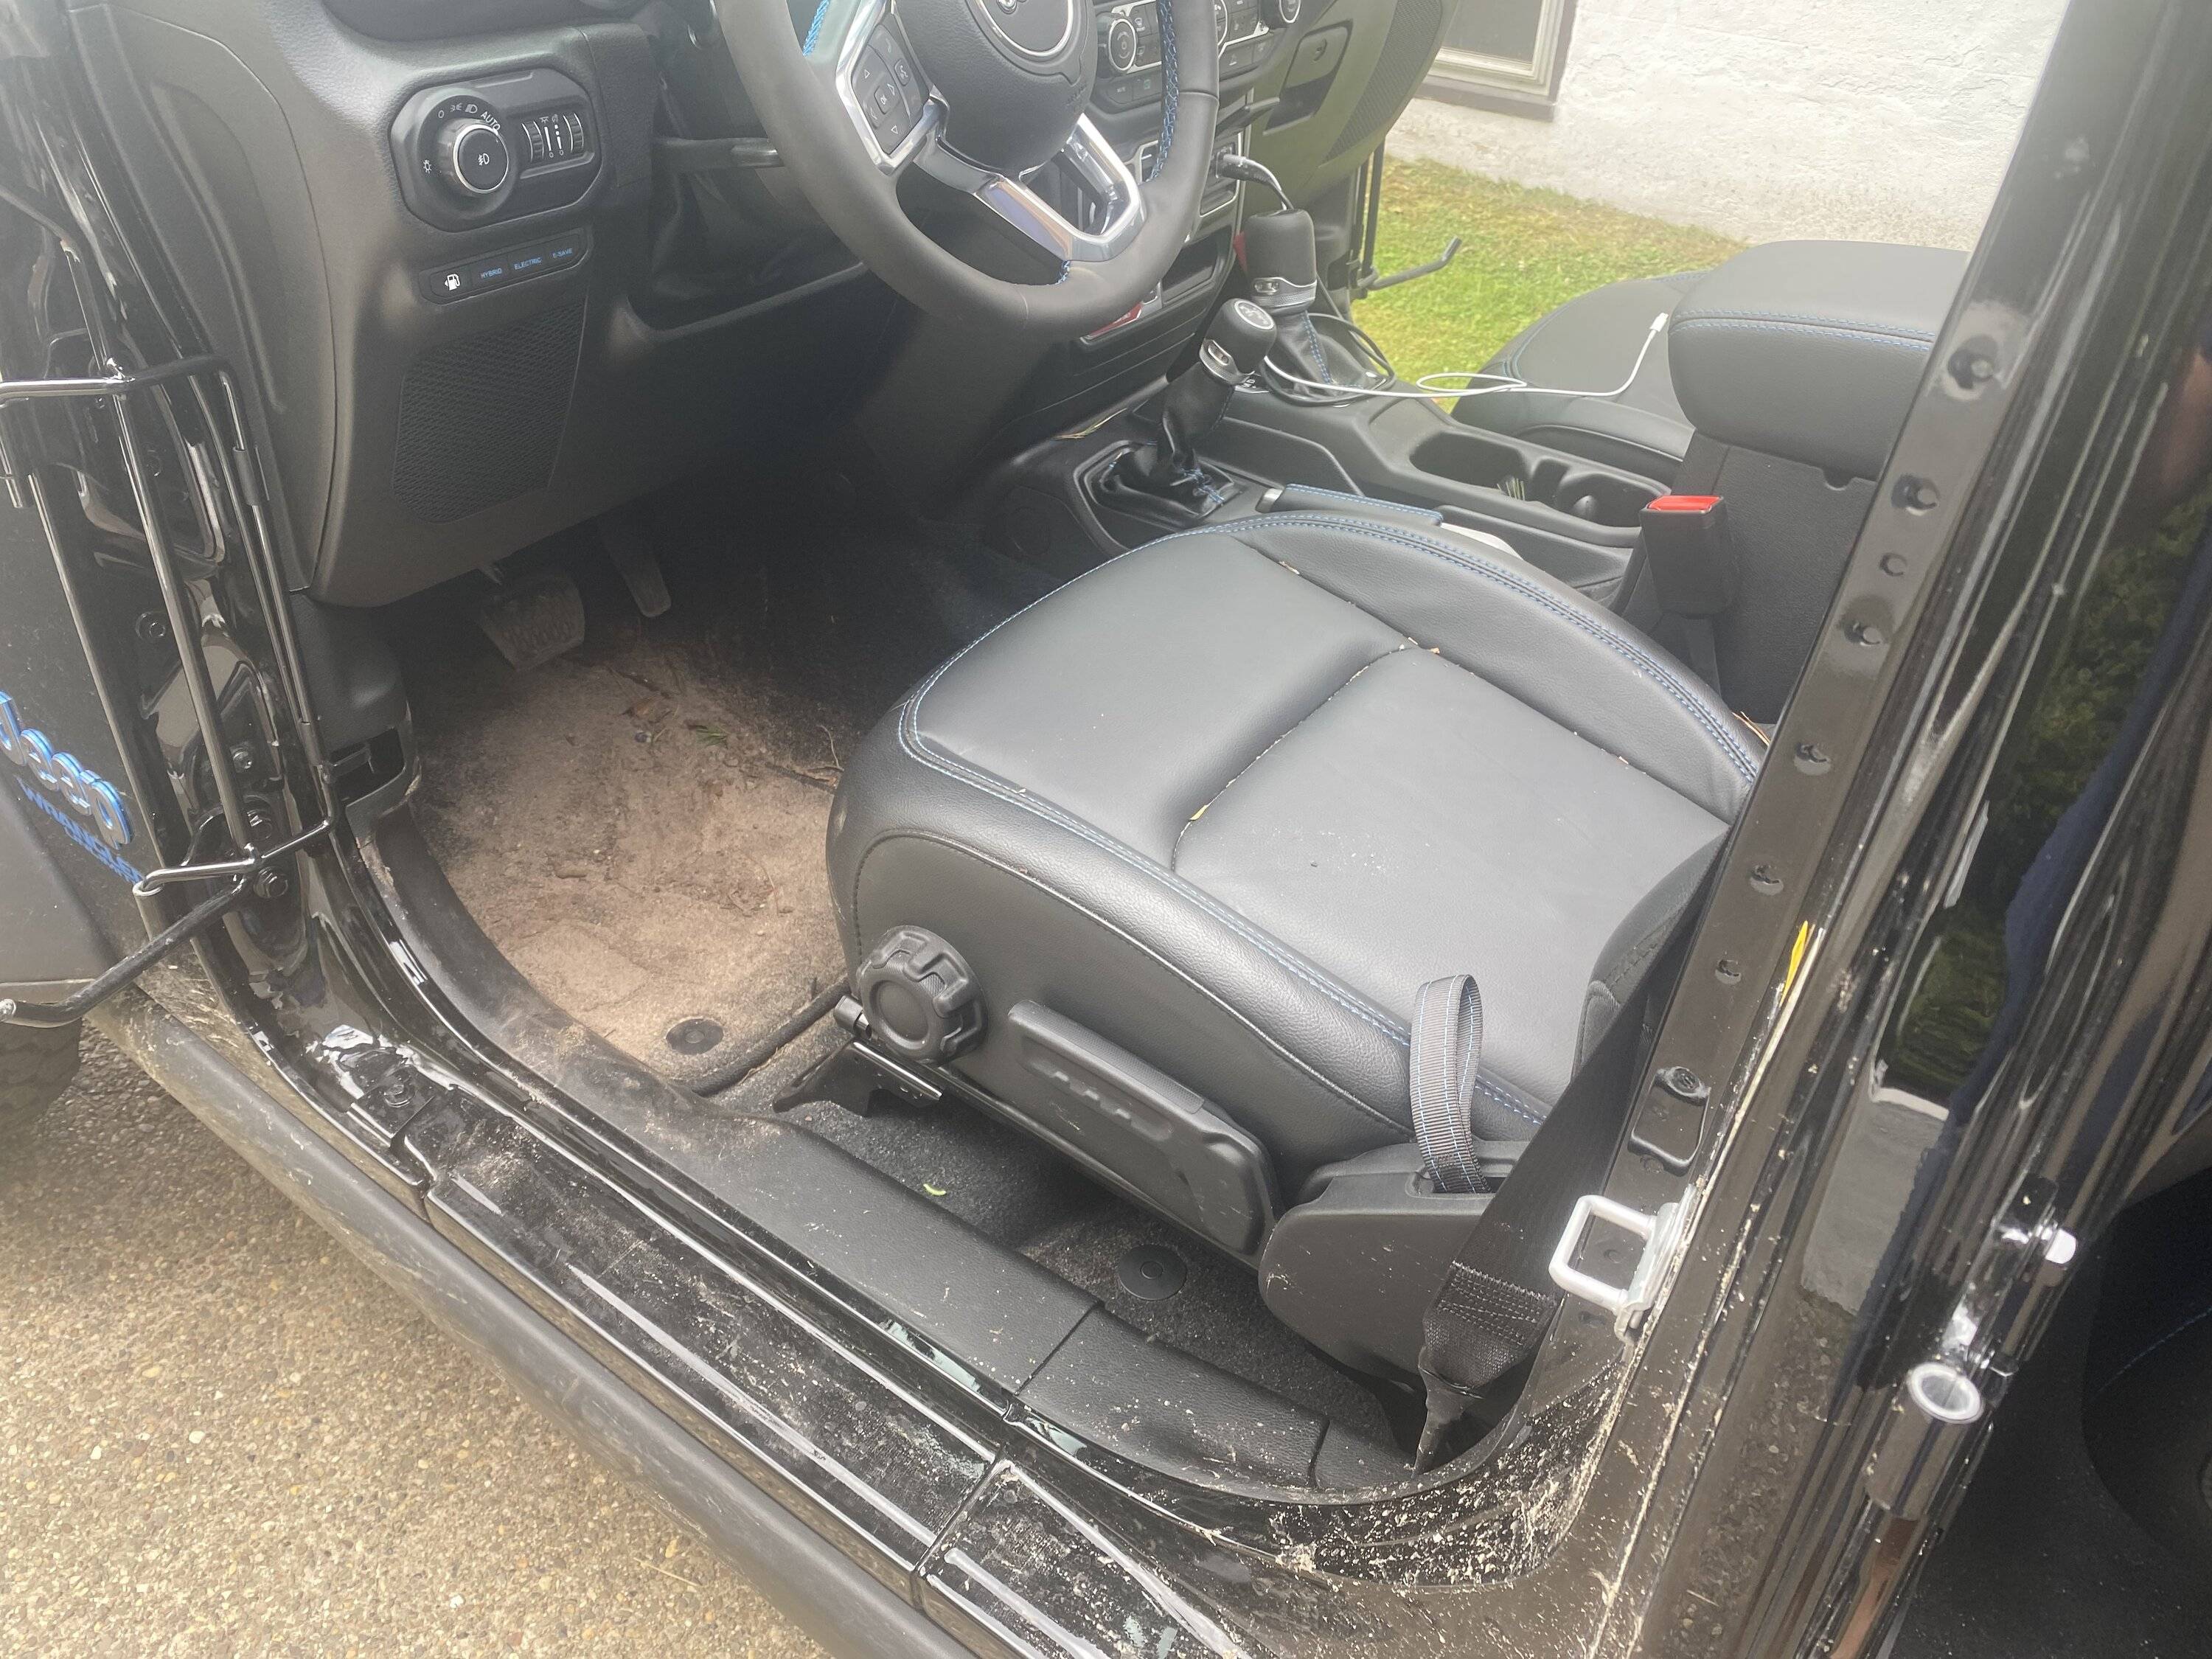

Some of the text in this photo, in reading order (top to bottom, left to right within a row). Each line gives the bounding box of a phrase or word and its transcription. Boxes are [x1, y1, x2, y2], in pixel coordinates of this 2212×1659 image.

[480, 111, 501, 131] AUTO
[514, 257, 542, 270] ELECTRIC
[481, 268, 502, 279] HYBRID
